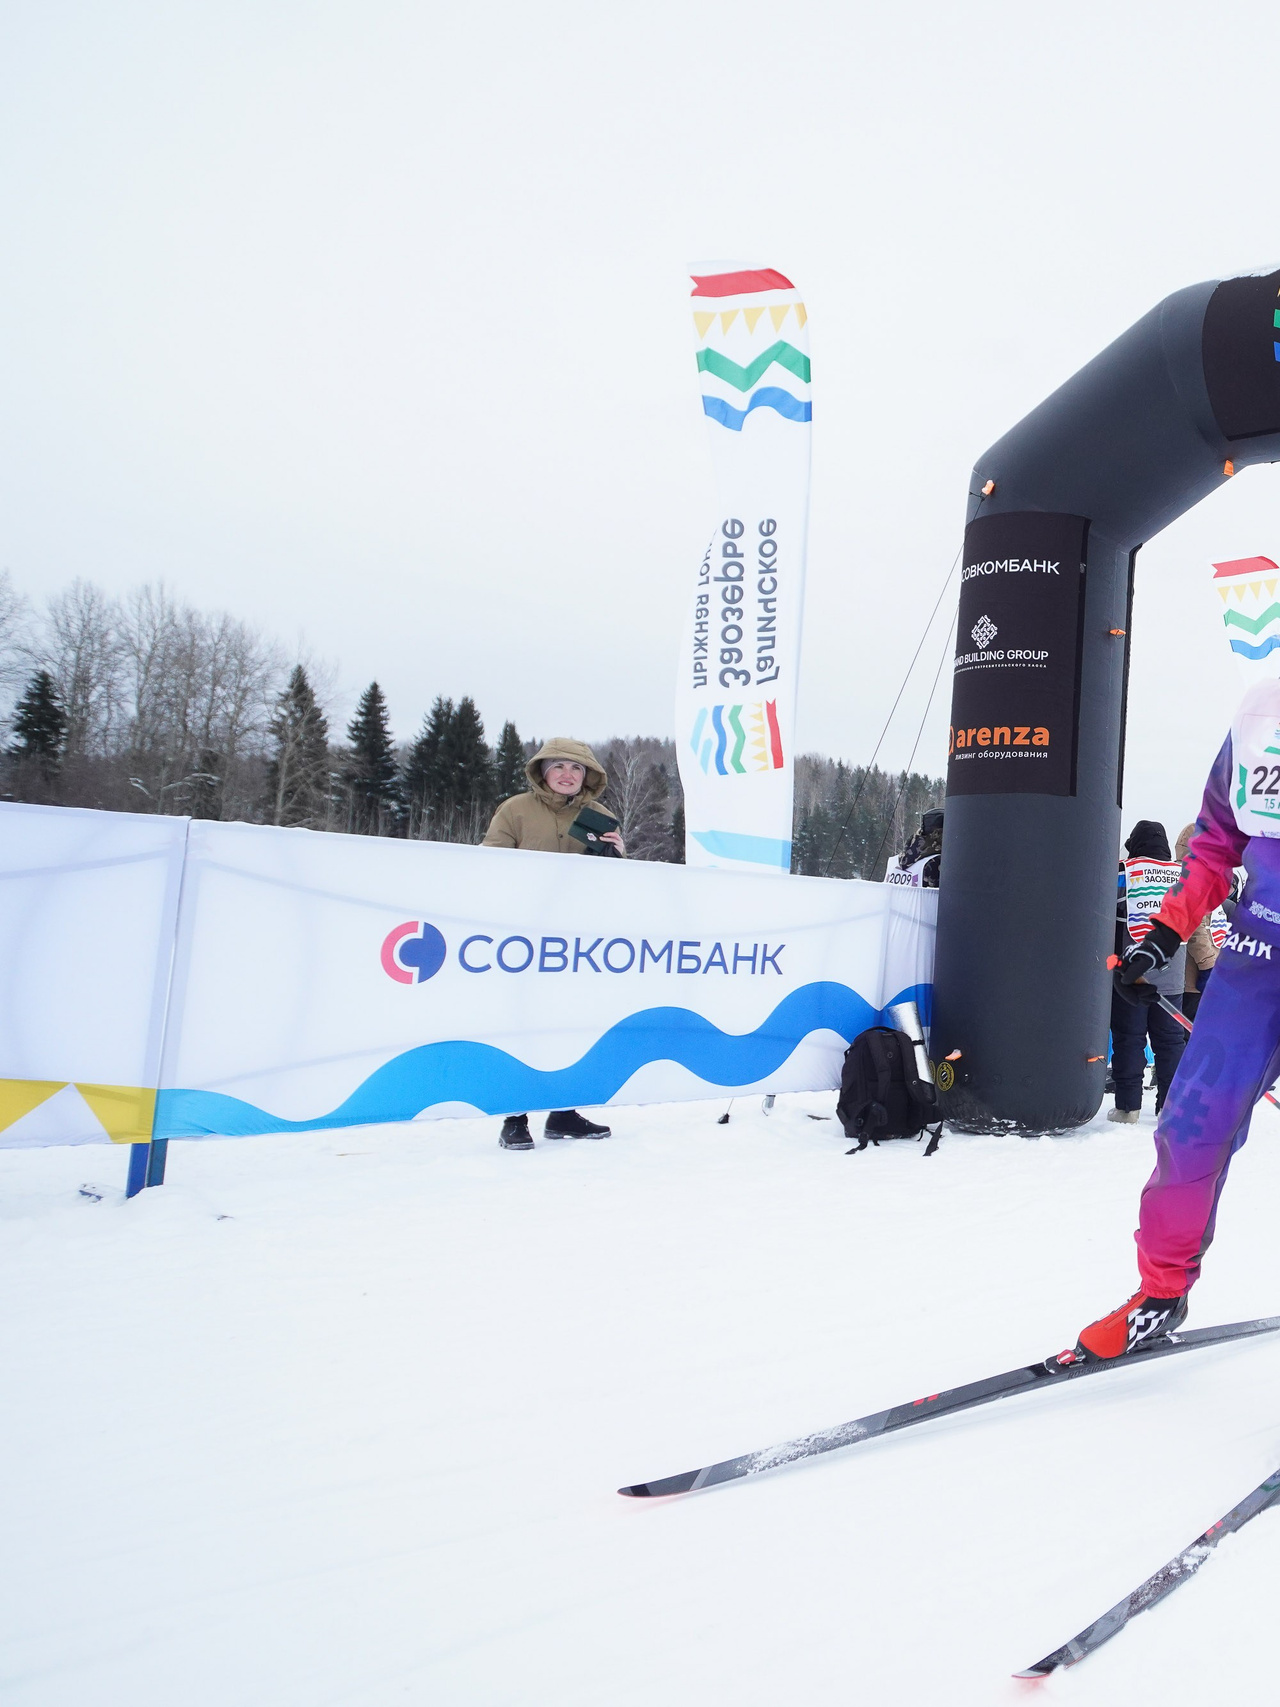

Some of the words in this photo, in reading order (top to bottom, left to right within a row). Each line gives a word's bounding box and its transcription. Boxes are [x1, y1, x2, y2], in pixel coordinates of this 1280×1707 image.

[964, 650, 1004, 664] BUILDING
[1007, 650, 1049, 661] GROUP
[956, 726, 1050, 748] arenza
[977, 750, 1048, 760] оборудования
[889, 873, 911, 886] 2009
[1144, 869, 1181, 877] ГАЛИЧСКО
[458, 934, 785, 975] СОВКОМБАНК
